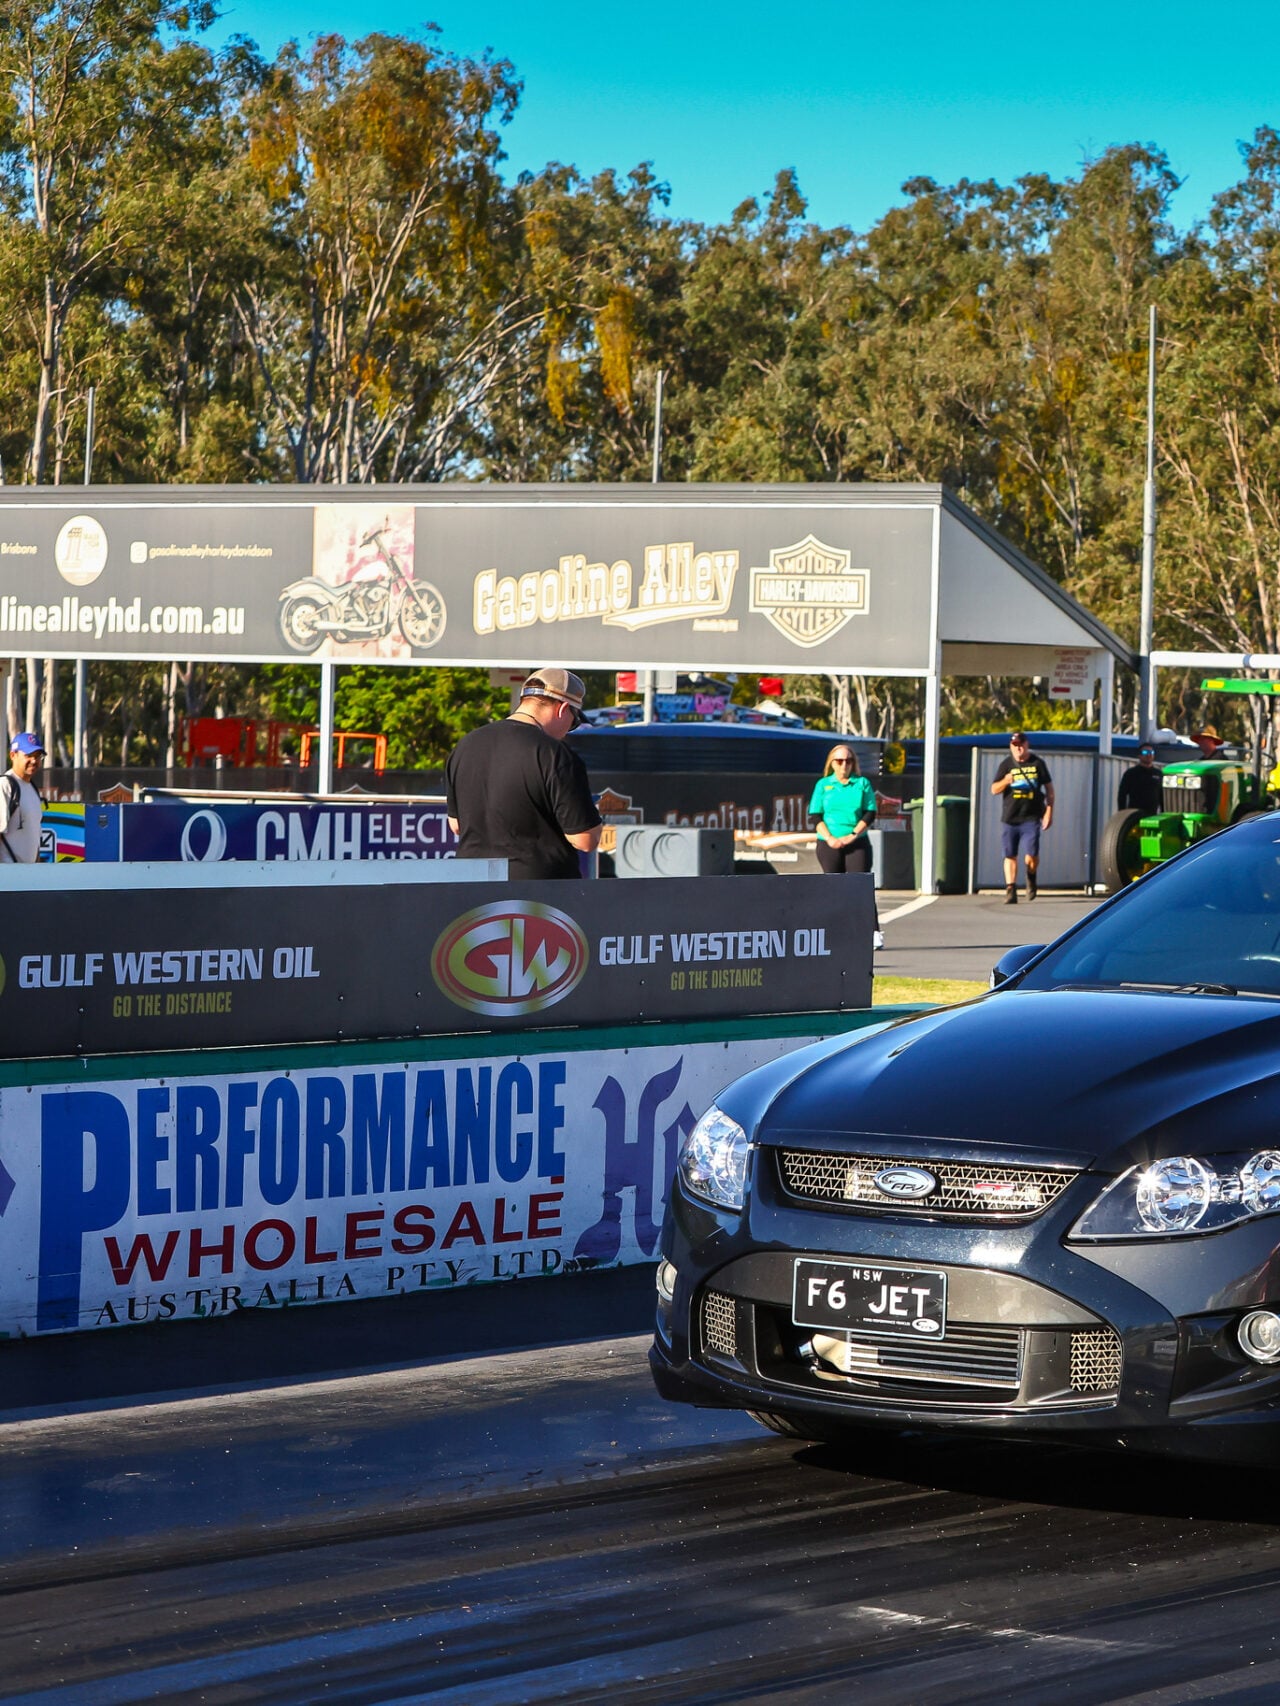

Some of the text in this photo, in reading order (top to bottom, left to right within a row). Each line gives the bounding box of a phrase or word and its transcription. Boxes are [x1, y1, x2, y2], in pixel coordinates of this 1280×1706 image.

[783, 556, 838, 575] MOTOR
[473, 541, 740, 635] Gasoline Alley
[760, 579, 861, 603] HARLEY-DAVIDSON
[781, 608, 840, 634] CYCLES
[256, 810, 460, 861] CMH ELECT
[598, 928, 832, 966] GULF WESTERN OIL
[18, 946, 320, 989] GULF WESTERN OIL
[670, 967, 763, 991] GO THE DISTANCE
[112, 991, 233, 1018] GO THE DISTANCE
[36, 1060, 568, 1332] PERFORMANCE
[103, 1190, 564, 1286] WHOLESALE
[95, 1248, 563, 1326] AUSTRALIA PTY LTD
[852, 1268, 882, 1282] NSW
[807, 1277, 931, 1318] F6 JET
